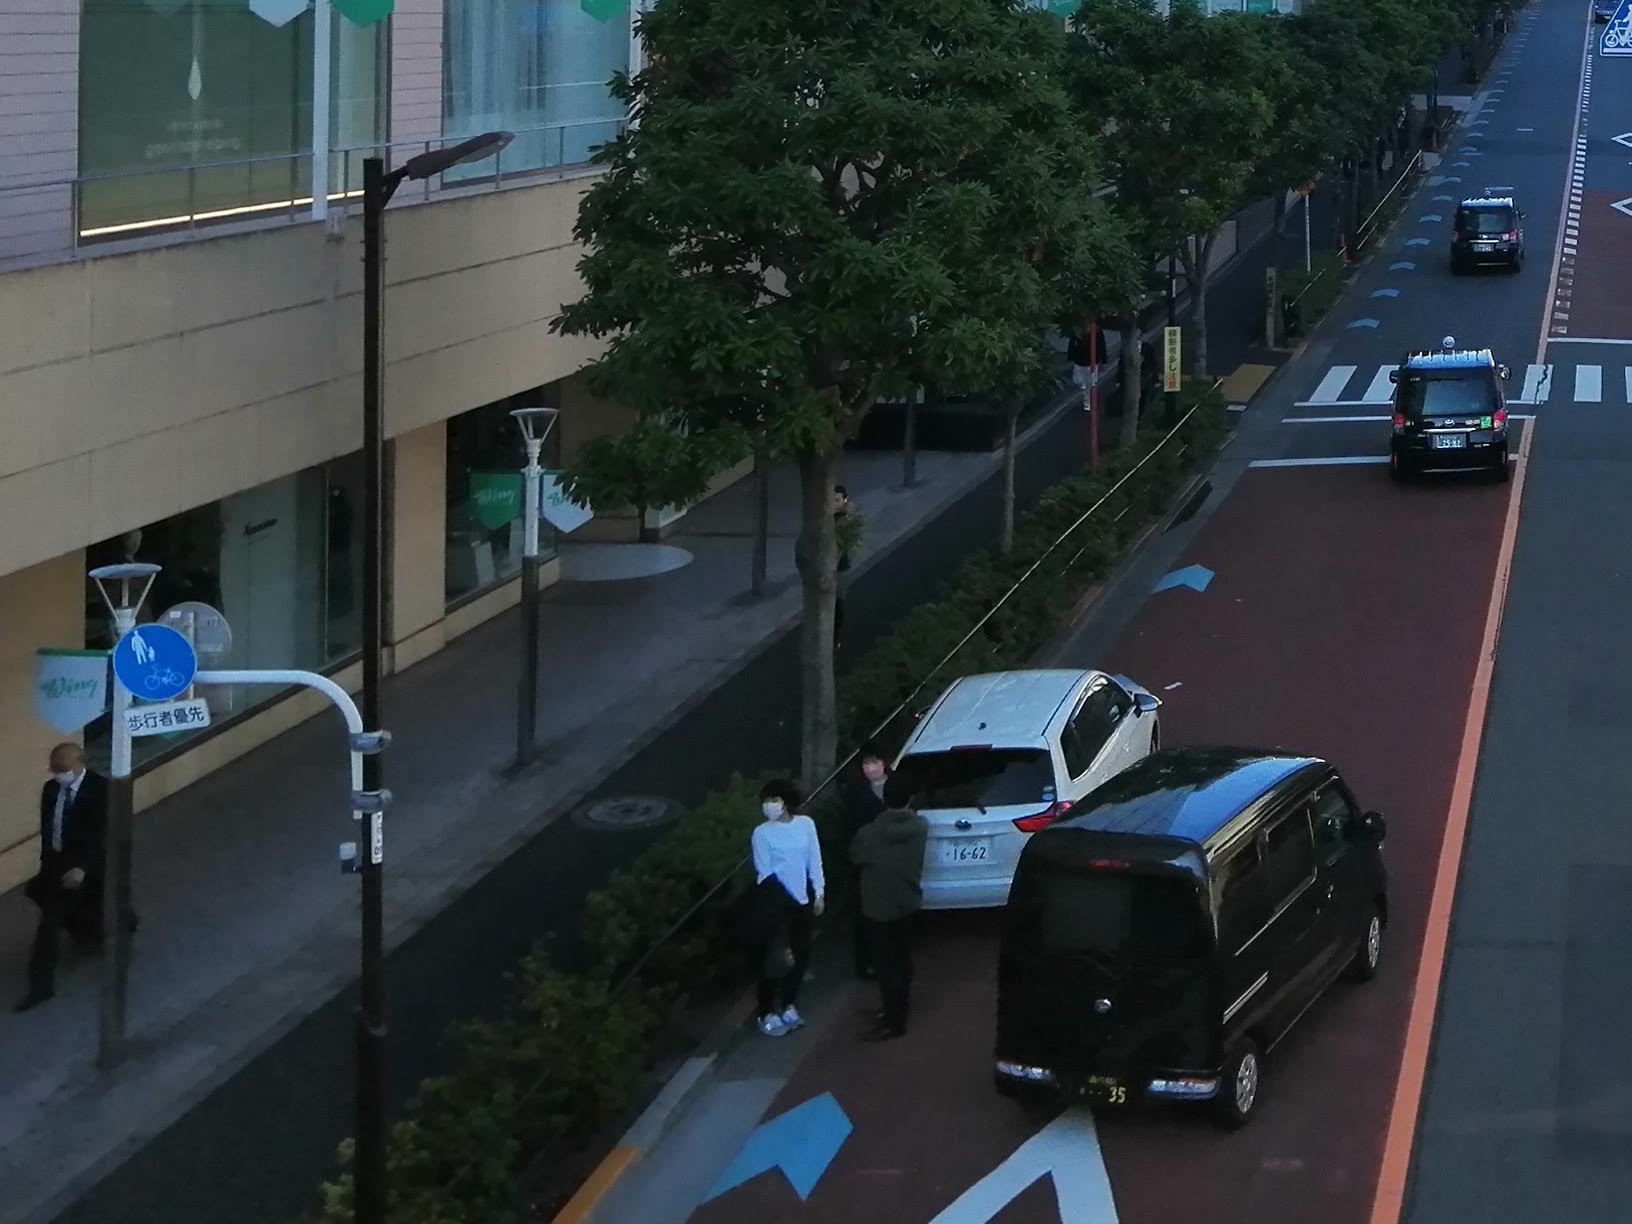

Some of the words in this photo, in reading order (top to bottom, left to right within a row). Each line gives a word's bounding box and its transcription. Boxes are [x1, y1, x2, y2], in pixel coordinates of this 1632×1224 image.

[39, 677, 98, 700] Wing
[127, 706, 206, 732] 歩行者優先
[953, 846, 987, 861] 16-62
